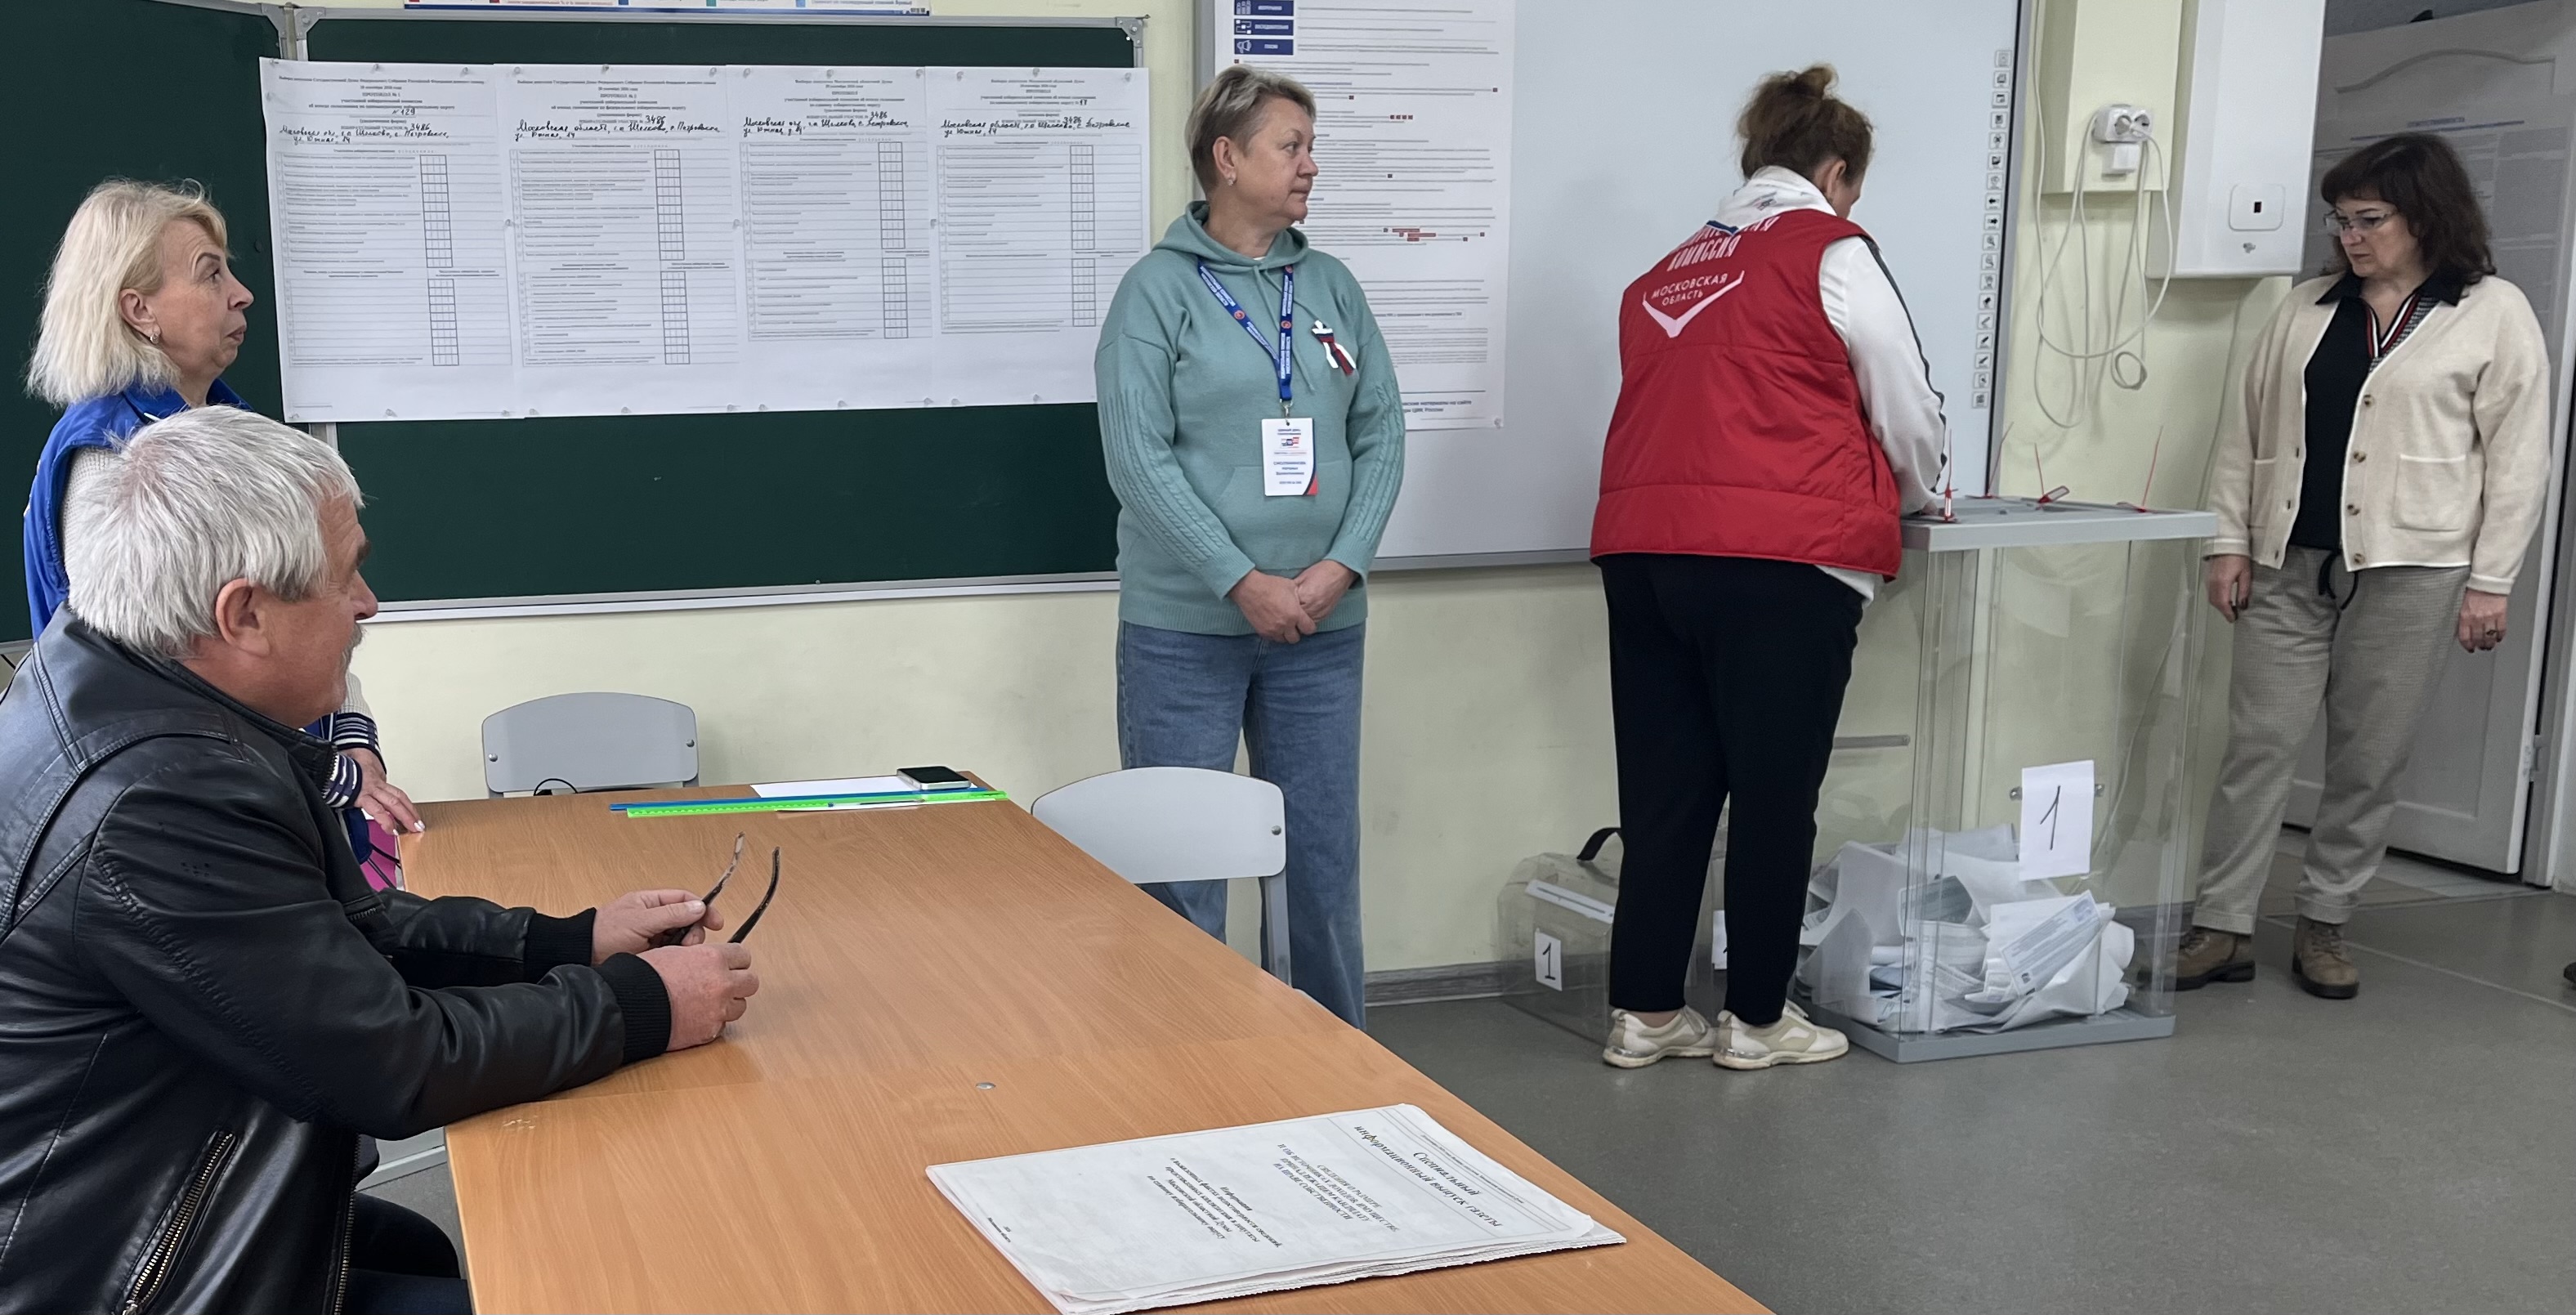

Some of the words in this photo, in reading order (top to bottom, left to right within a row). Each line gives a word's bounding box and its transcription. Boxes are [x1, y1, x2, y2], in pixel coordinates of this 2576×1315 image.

[410, 123, 430, 131] 3486
[1666, 235, 1742, 272] КОМИССИЯ
[1651, 273, 1729, 300] МОСКОВСКАЯ
[1661, 288, 1704, 306] ОБЛАСТЬ
[2039, 785, 2061, 851] 1
[1543, 942, 1556, 980] 1
[1354, 1126, 1435, 1181] информационный
[1429, 1182, 1469, 1205] выпуск
[1465, 1205, 1502, 1227] газеты
[1413, 1152, 1482, 1195] Специальный
